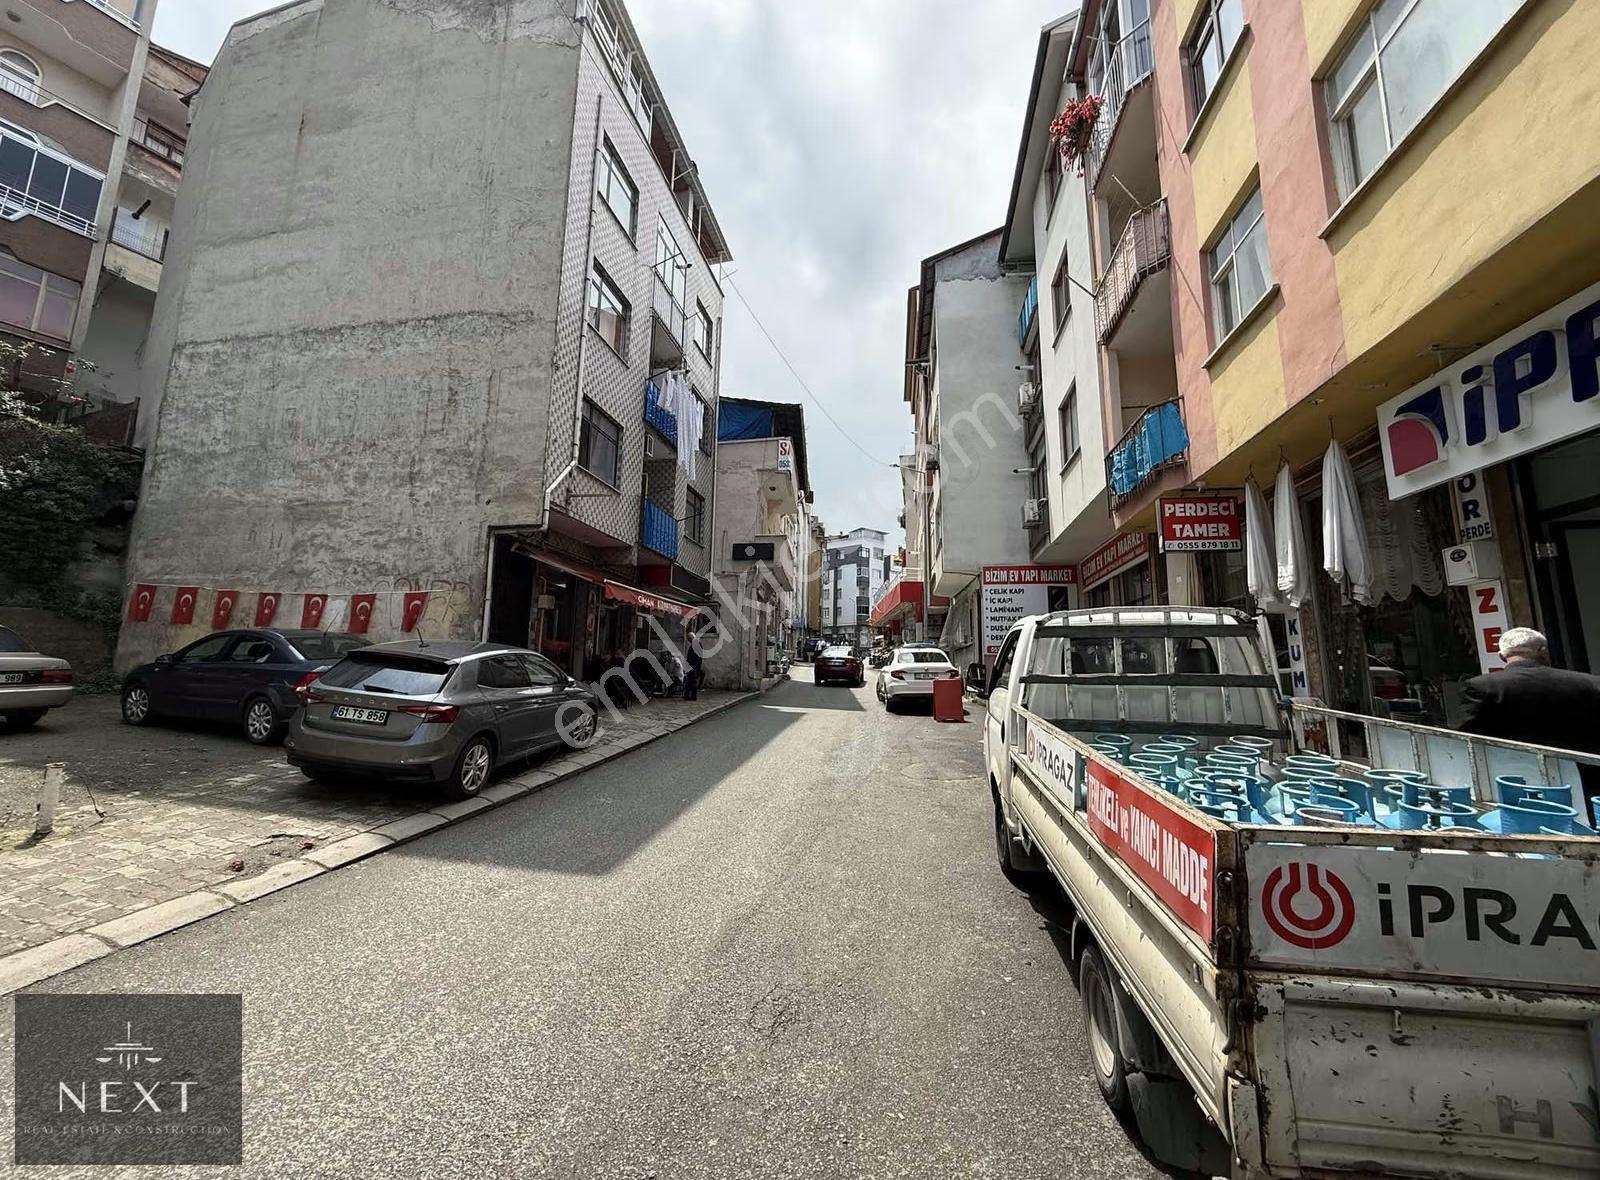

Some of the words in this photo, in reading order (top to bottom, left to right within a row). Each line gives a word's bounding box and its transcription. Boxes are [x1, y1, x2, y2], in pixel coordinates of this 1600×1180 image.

[1164, 499, 1235, 517] PERDECİ
[1172, 523, 1230, 537] TAMER
[1460, 522, 1491, 541] PERDE
[1177, 541, 1199, 549] 0555
[985, 568, 1008, 582] BİZİM
[1009, 570, 1019, 582] EV
[1020, 569, 1038, 582] YAPI
[1040, 569, 1072, 581] MARKET
[1475, 587, 1505, 673] ZE
[338, 707, 349, 717] 61
[352, 709, 363, 719] TS
[366, 711, 385, 721] 858
[1130, 804, 1160, 873] YANICI
[1162, 828, 1208, 914] MADDE
[1377, 883, 1600, 950] iPRA
